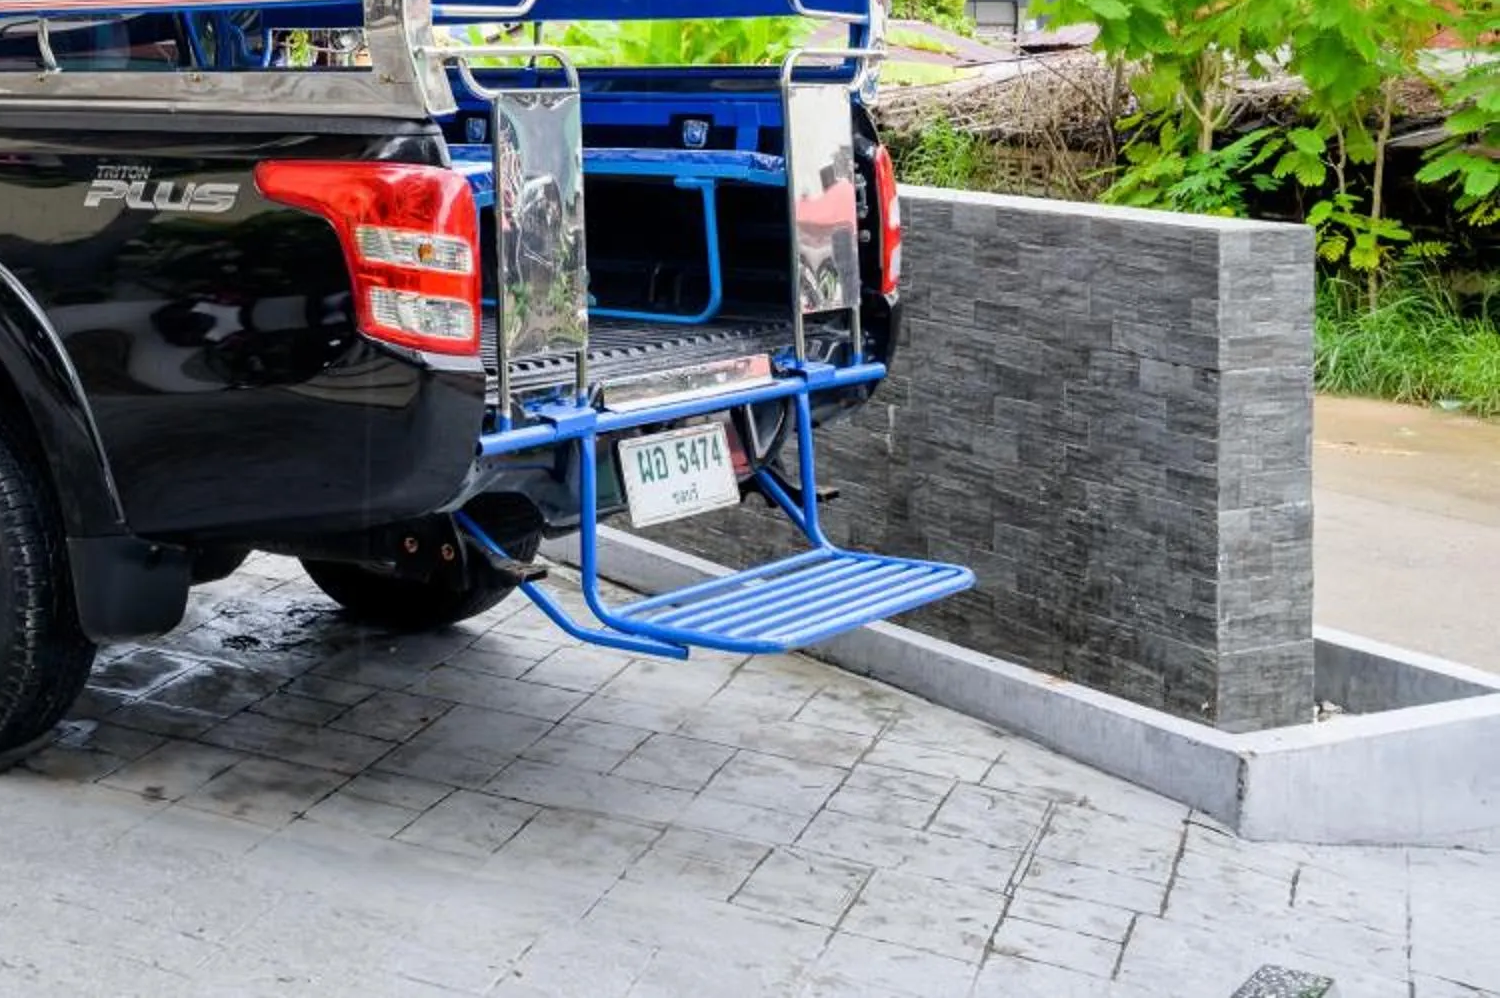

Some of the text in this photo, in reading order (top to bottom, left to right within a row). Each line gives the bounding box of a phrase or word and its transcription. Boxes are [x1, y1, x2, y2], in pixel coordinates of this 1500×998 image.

[97, 165, 151, 179] TRITON
[83, 179, 240, 213] PLUS
[675, 433, 723, 476] 5474
